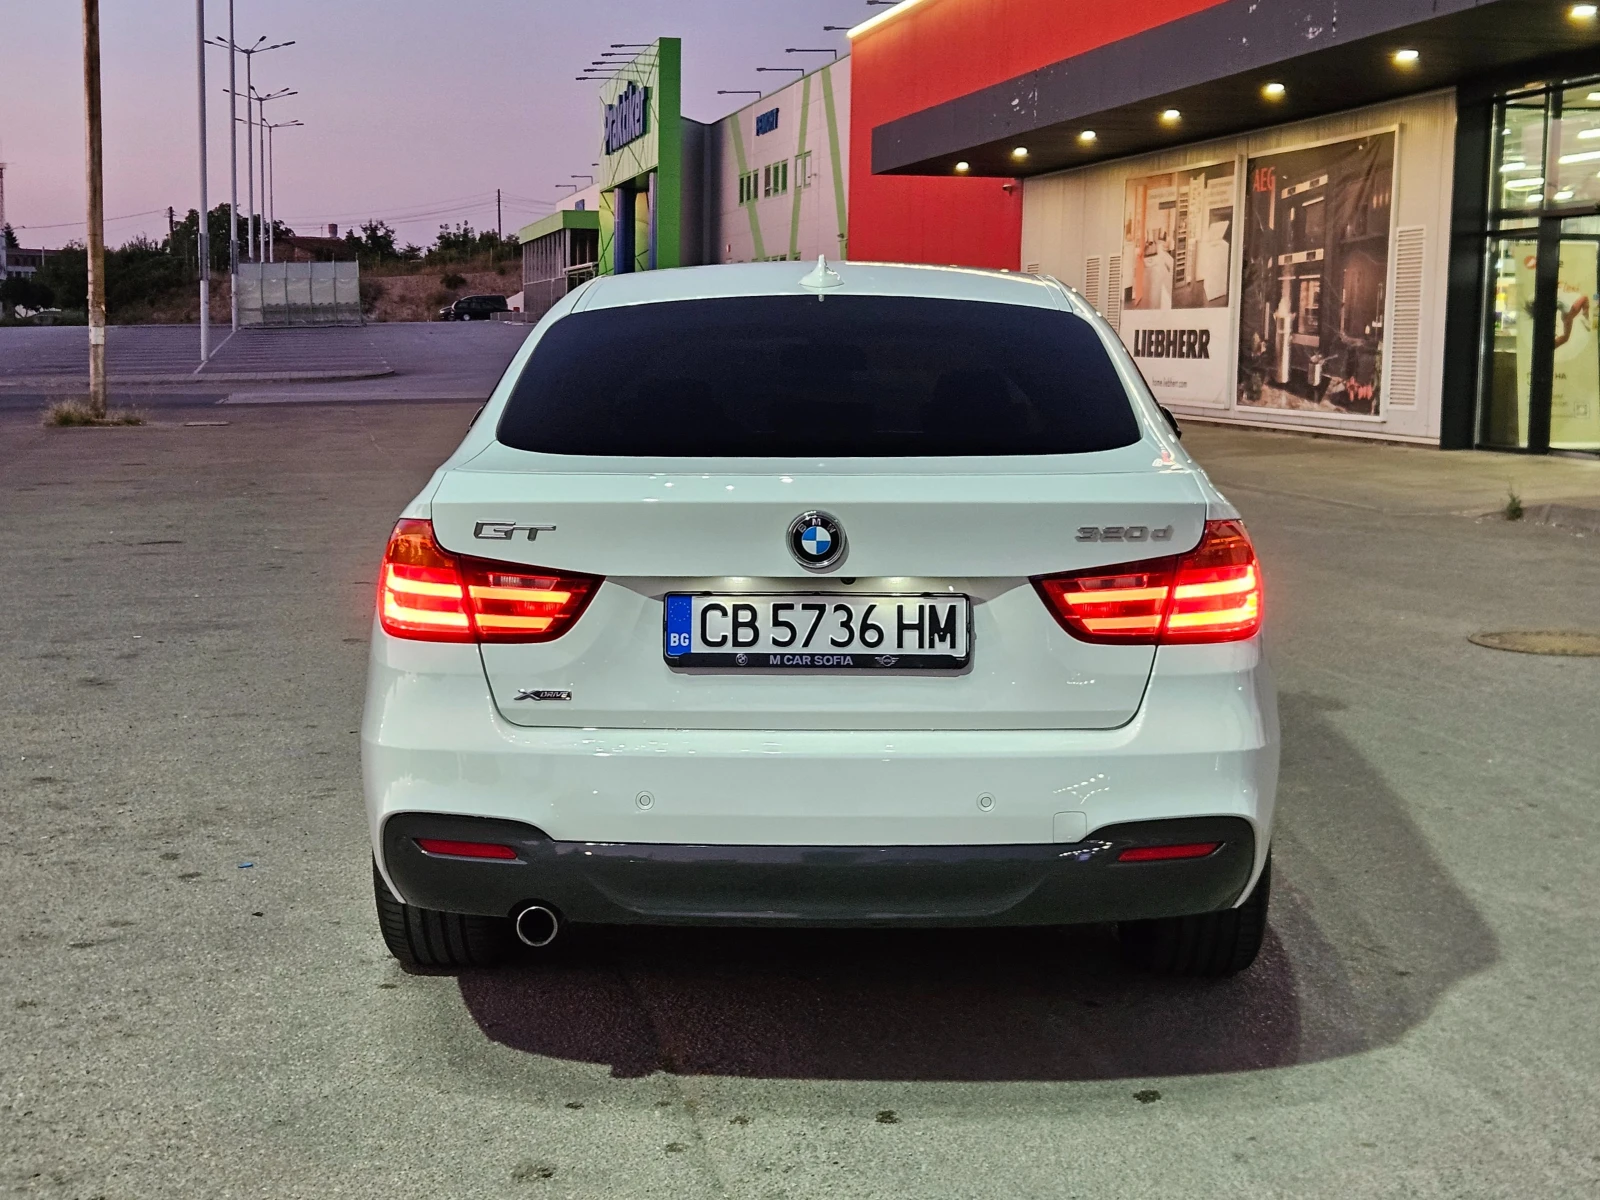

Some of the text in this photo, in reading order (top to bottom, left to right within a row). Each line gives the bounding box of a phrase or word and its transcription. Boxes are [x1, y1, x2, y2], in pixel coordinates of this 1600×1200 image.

[604, 81, 649, 156] Praktiker
[1253, 166, 1276, 192] AEG
[1133, 329, 1210, 360] LIEBHERR
[473, 520, 557, 542] GT
[797, 518, 837, 534] BMW
[1074, 524, 1175, 543] 320d
[700, 602, 957, 650] CB 5736 HM
[669, 632, 690, 647] BG
[769, 655, 853, 666] M CAR SOFIA
